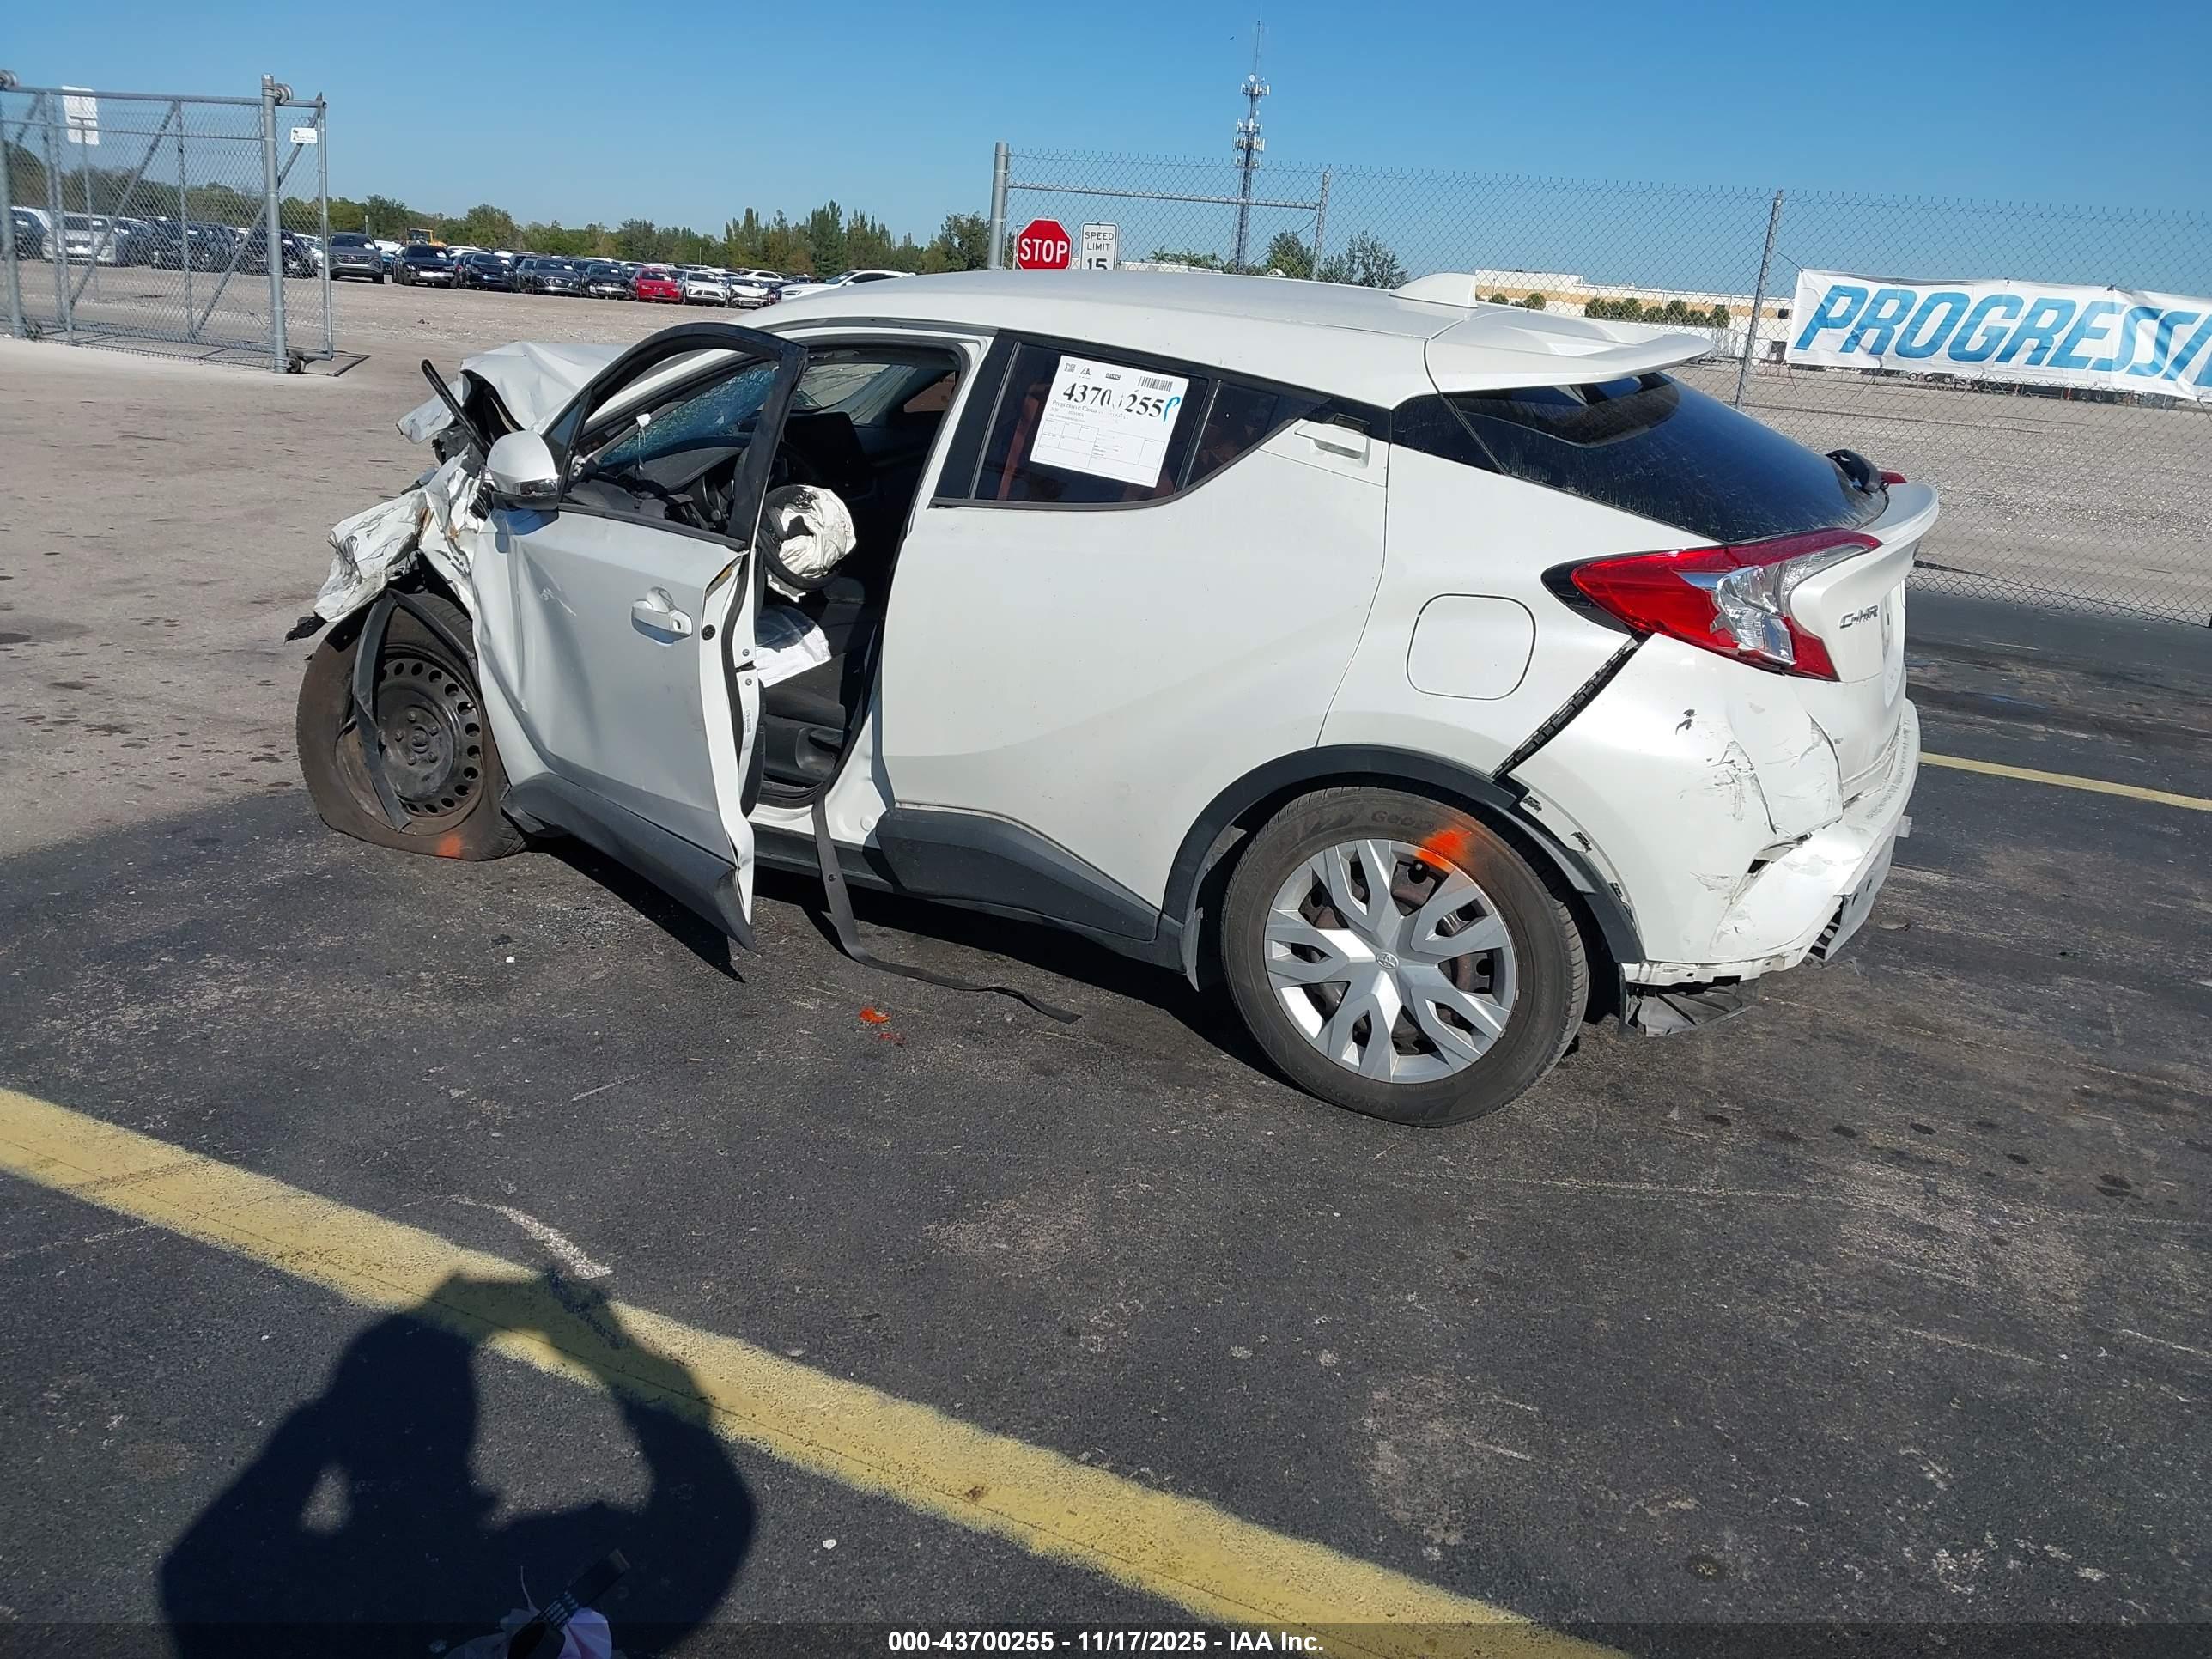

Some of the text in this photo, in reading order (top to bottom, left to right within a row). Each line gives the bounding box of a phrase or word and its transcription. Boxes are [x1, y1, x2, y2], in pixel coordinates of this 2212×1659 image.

[1085, 231, 1114, 241] SPEED
[1086, 242, 1110, 252] LIMIT
[1020, 238, 1068, 263] STOP
[1794, 284, 2212, 387] PROGRESSI
[1839, 605, 1879, 629] C-HR
